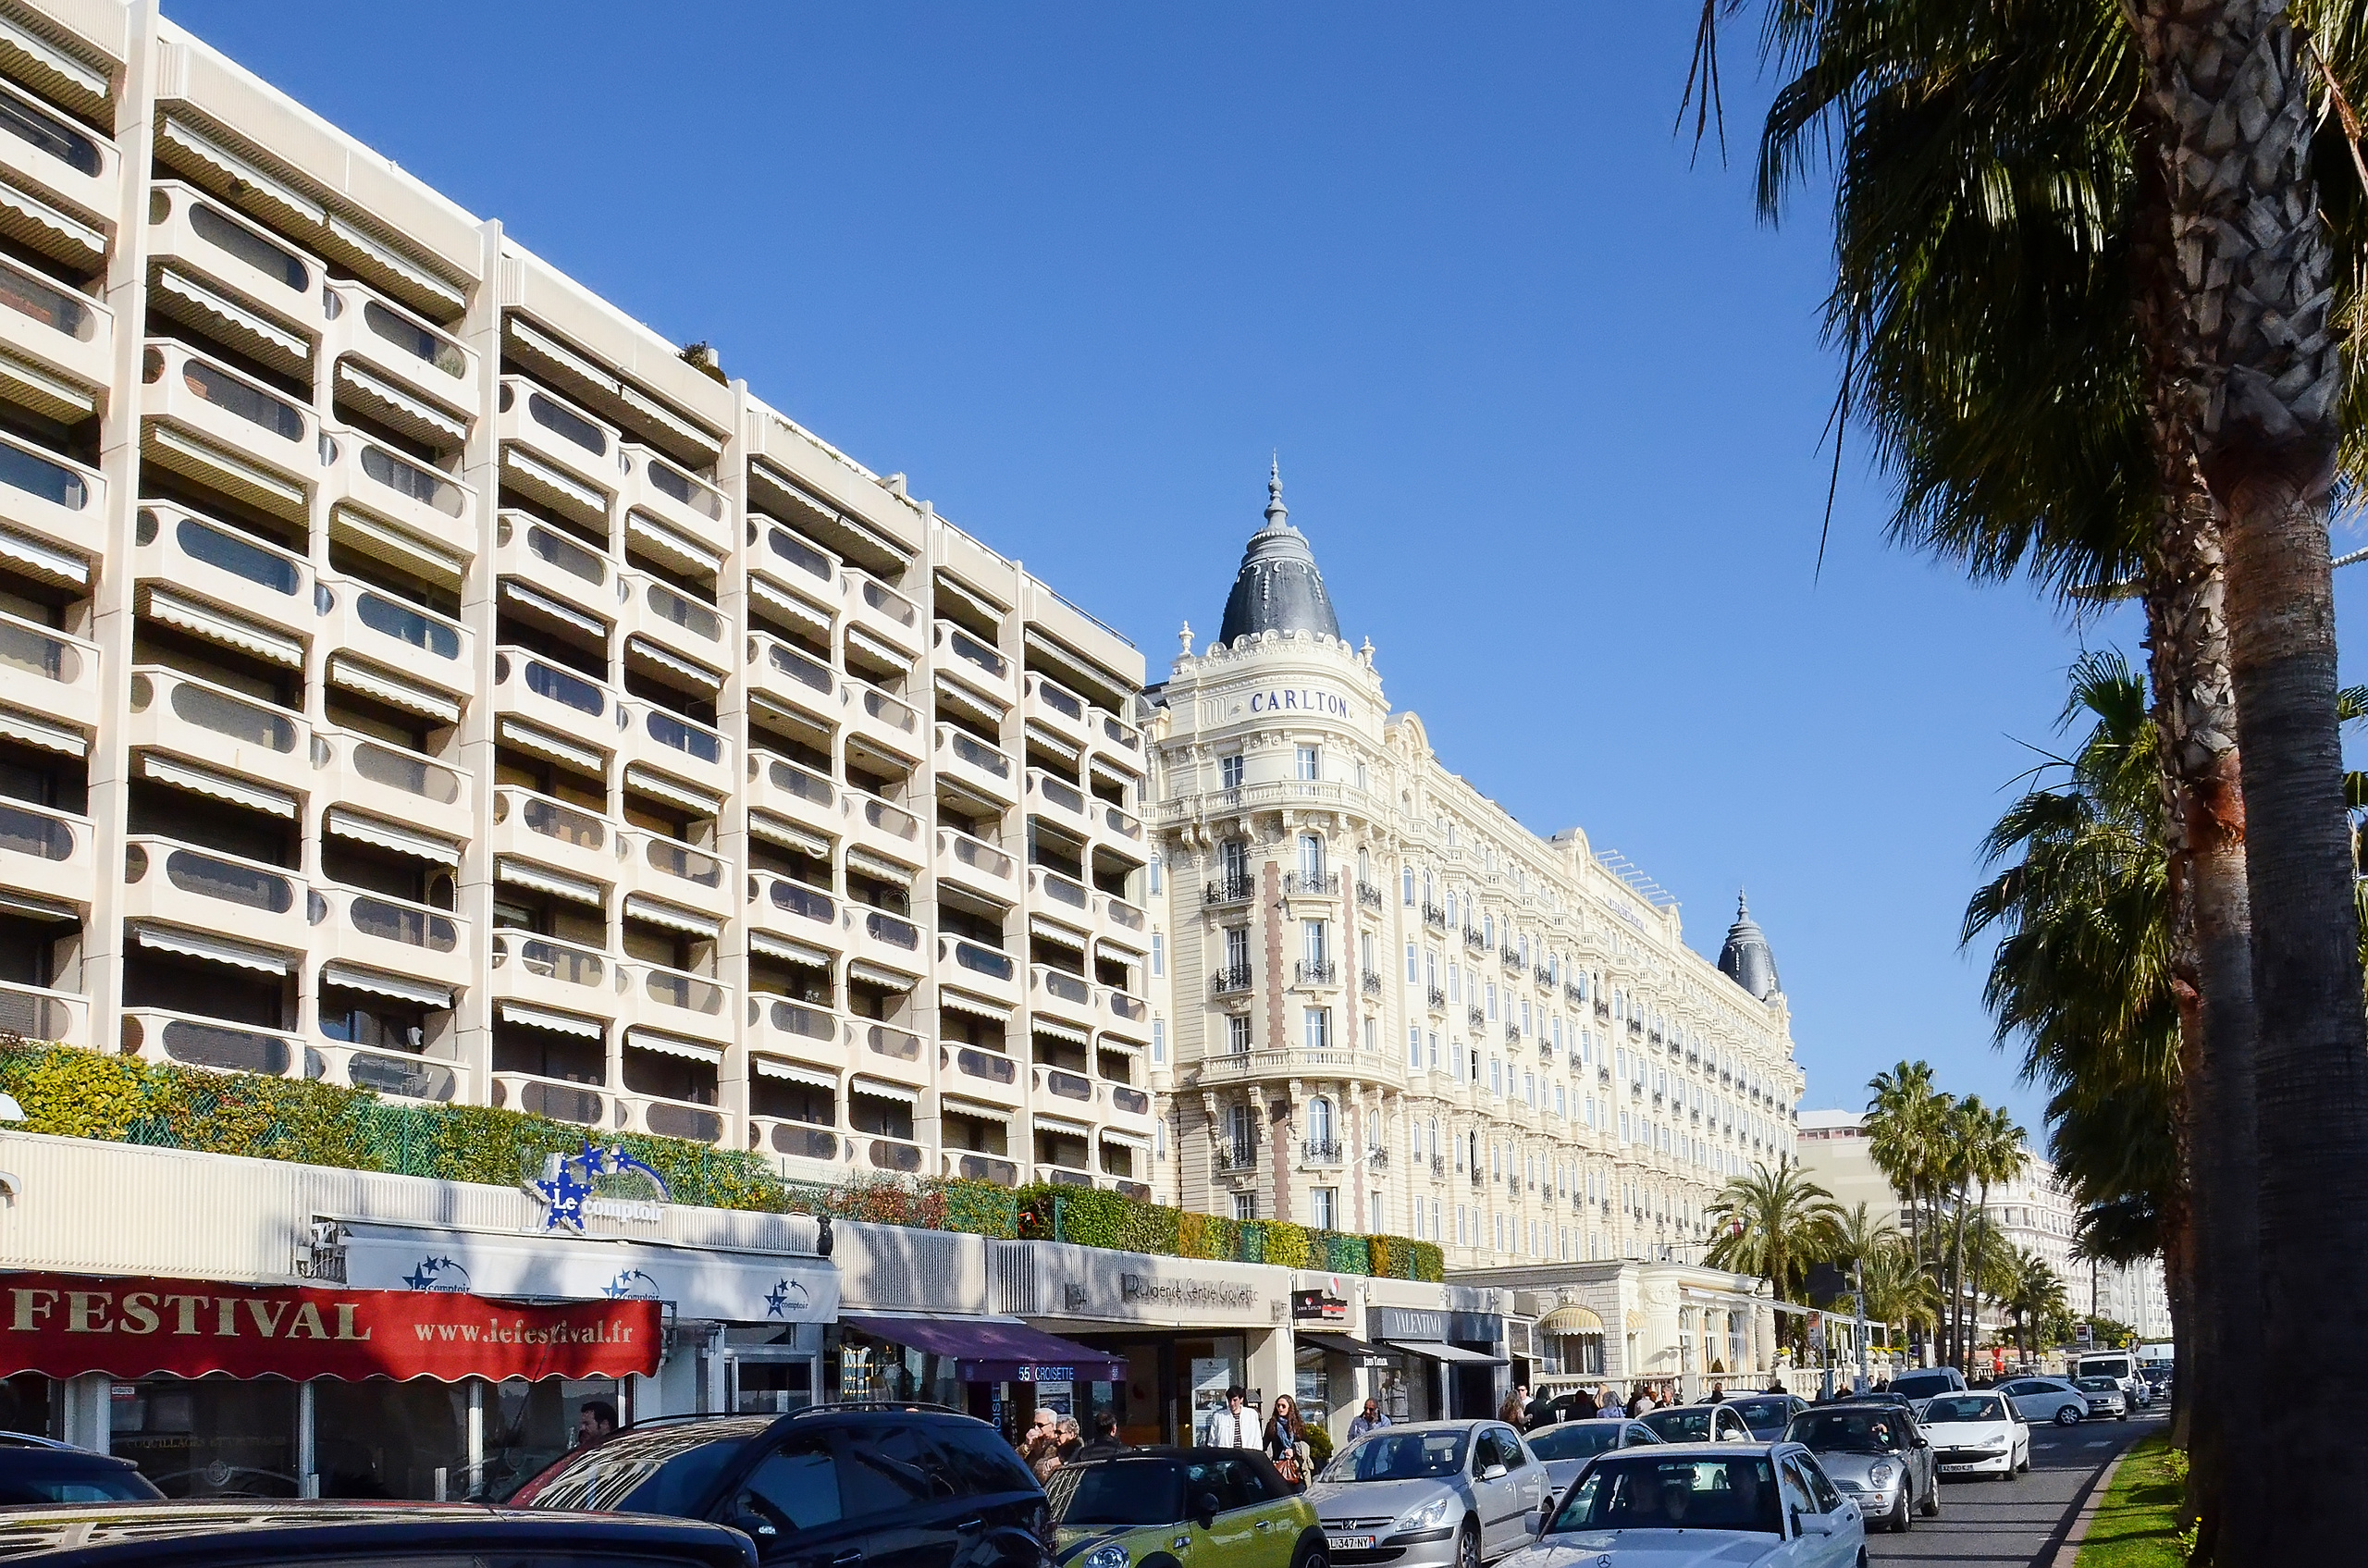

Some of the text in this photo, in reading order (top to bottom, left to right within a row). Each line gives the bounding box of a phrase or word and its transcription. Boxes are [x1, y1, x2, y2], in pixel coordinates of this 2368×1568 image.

[1252, 689, 1348, 719] CARLTON
[553, 1188, 664, 1224] Le comptoir
[7, 1288, 372, 1340] FESTIVAL
[1395, 1312, 1441, 1333] VALENTINO
[413, 1318, 634, 1344] www.lefestival.fr
[1018, 1366, 1074, 1381] 55 CROISETTE
